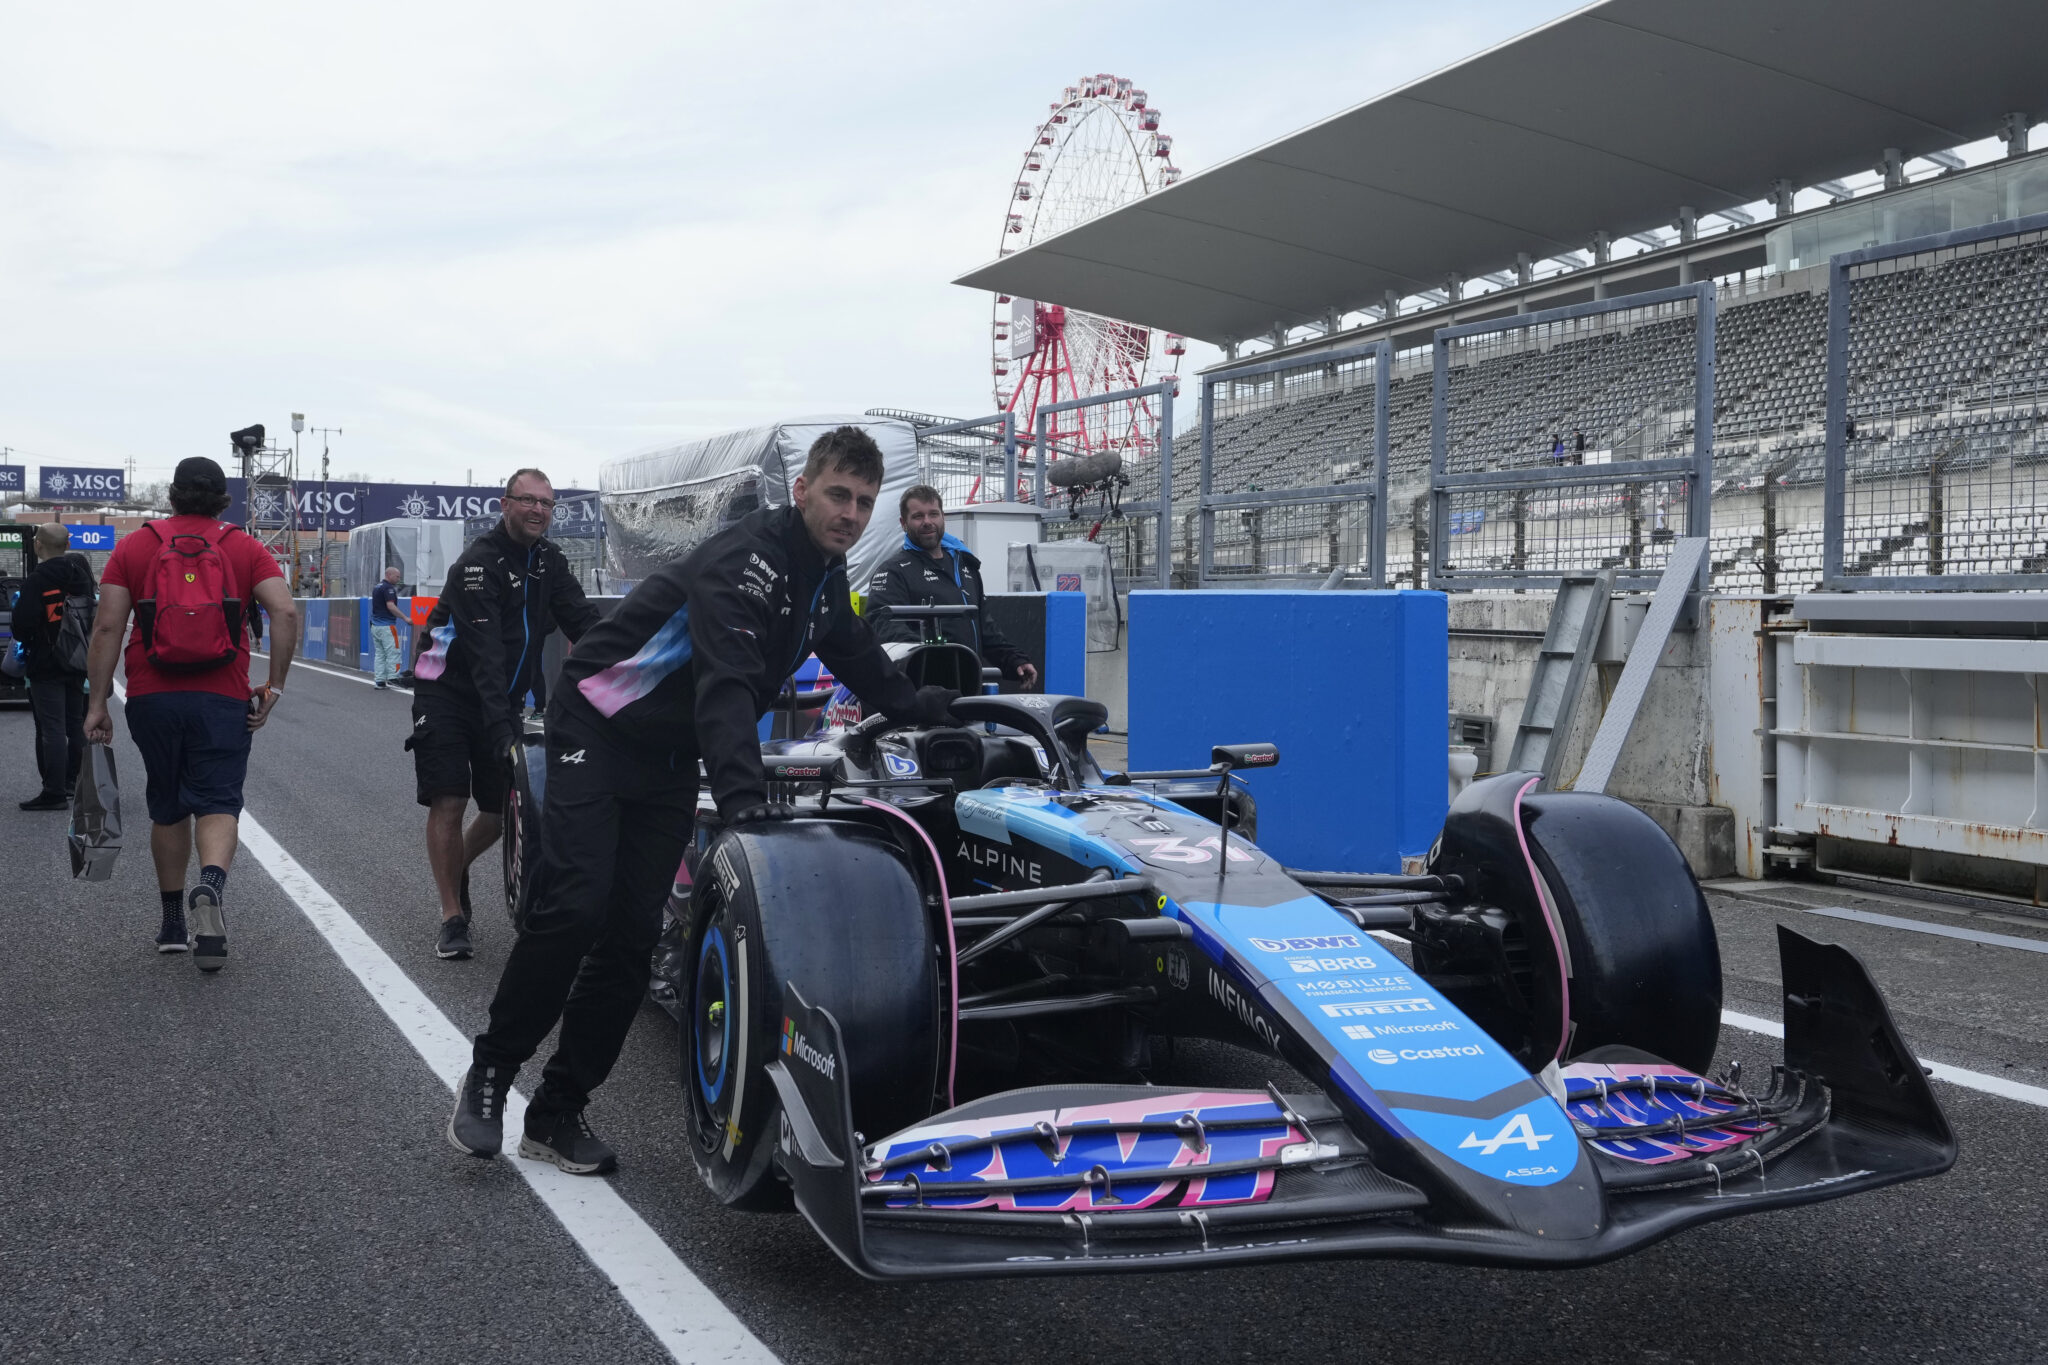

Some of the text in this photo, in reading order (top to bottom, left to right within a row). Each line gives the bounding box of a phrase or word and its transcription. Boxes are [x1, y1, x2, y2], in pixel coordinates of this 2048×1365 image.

[0, 472, 17, 482] SC
[73, 474, 120, 490] MSC
[285, 490, 356, 515] MSC
[82, 532, 100, 544] 0.0
[758, 559, 779, 581] BWT
[1252, 753, 1275, 763] Castrol
[786, 766, 821, 777] Castrol
[957, 841, 1042, 884] ALPINE
[713, 843, 741, 902] PIRELLI
[1282, 935, 1361, 951] BWT
[1317, 956, 1377, 972] BRB
[1305, 985, 1412, 997] FINANCIAL SERVICES
[1319, 998, 1437, 1018] PIRELLI
[1374, 1020, 1460, 1036] Microsoft
[794, 1031, 836, 1080] Microsoft
[1400, 1044, 1485, 1061] Castrol
